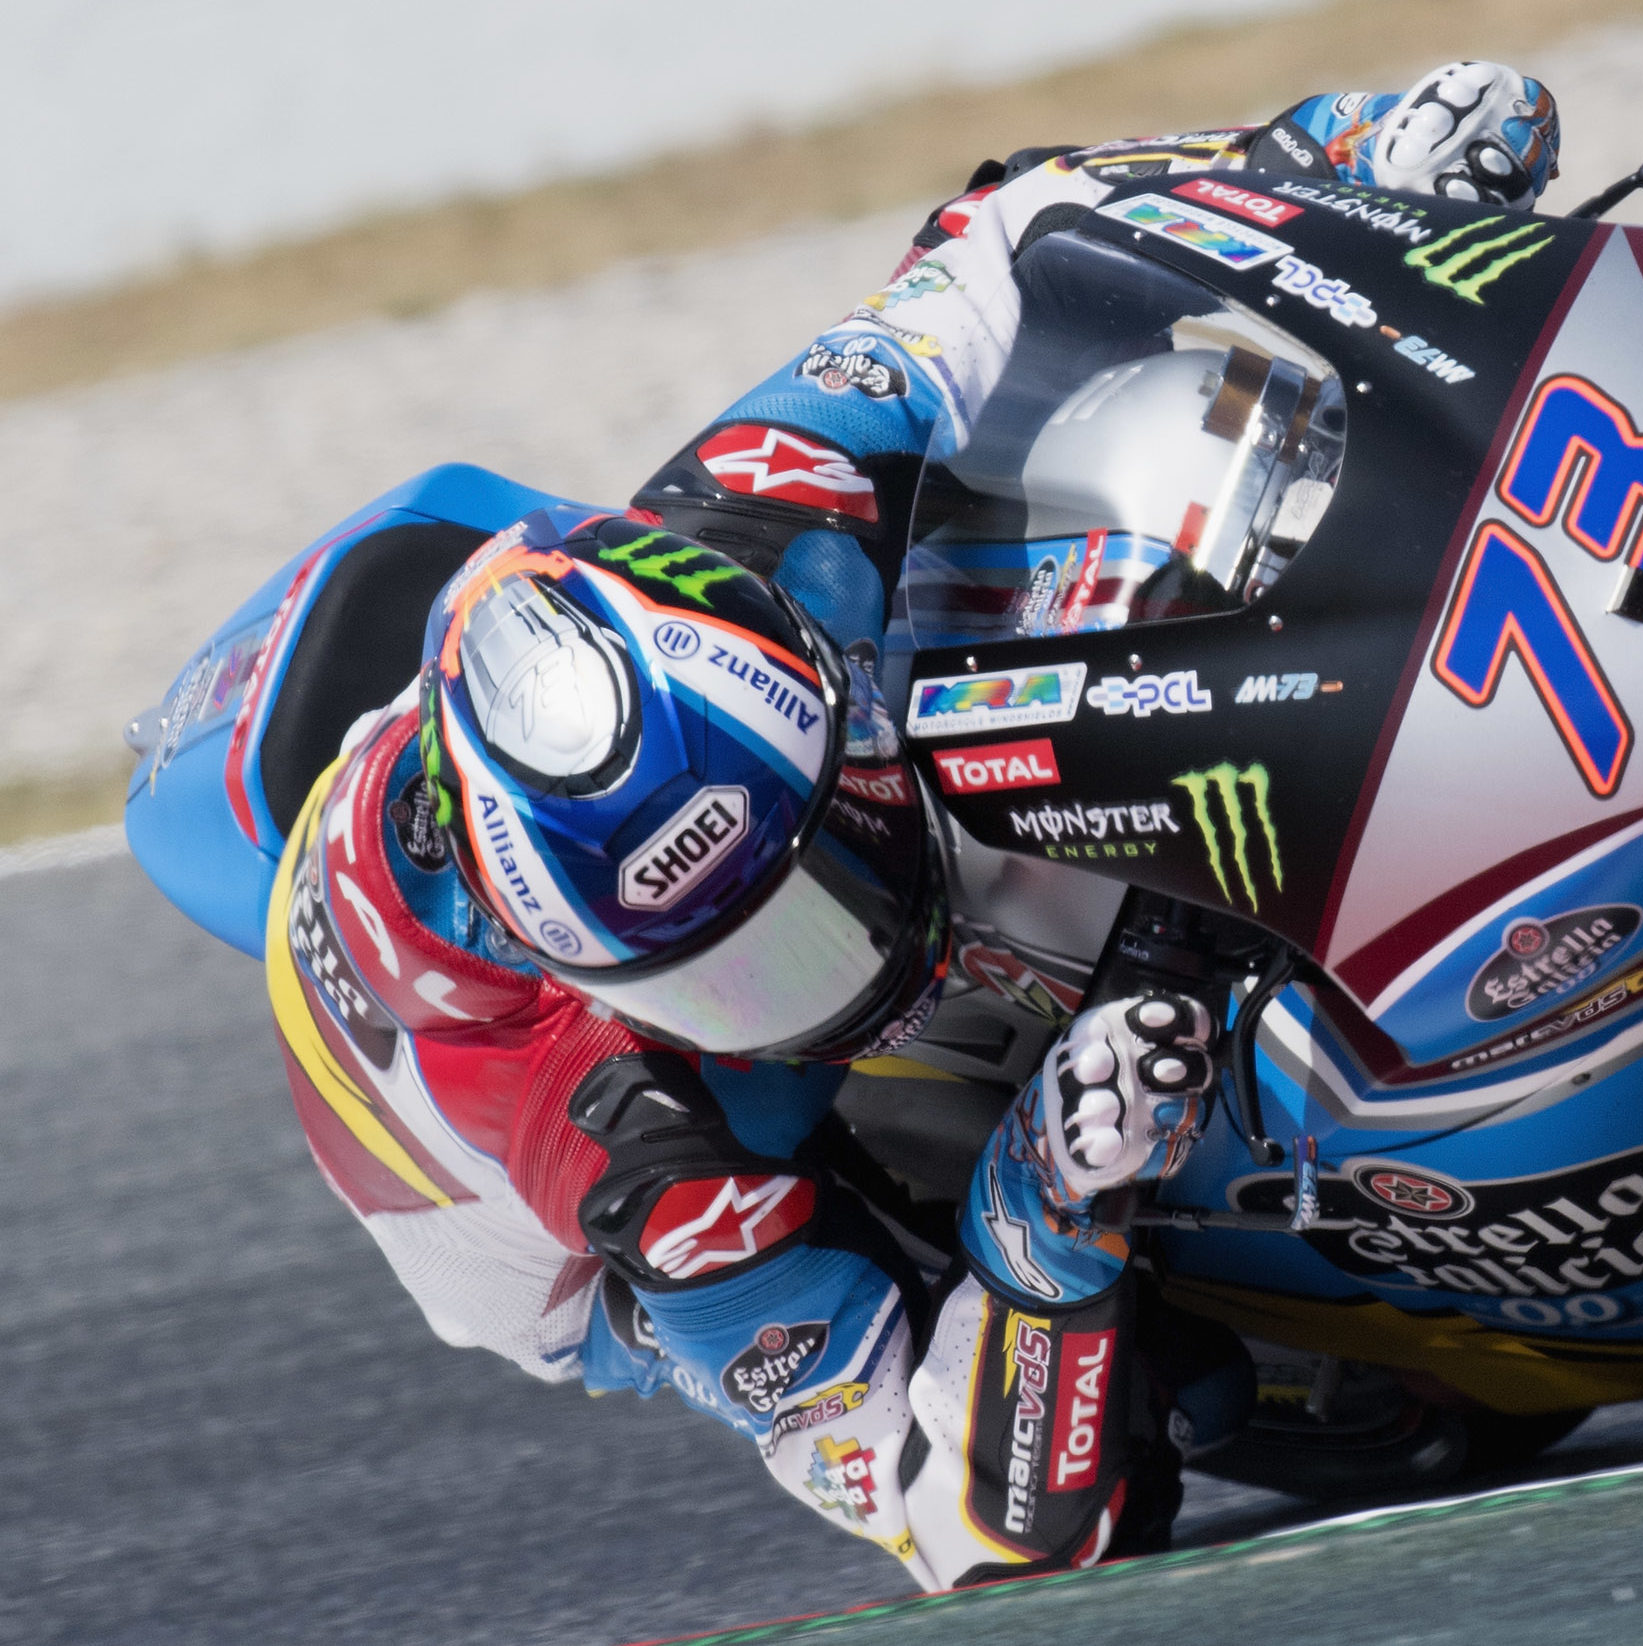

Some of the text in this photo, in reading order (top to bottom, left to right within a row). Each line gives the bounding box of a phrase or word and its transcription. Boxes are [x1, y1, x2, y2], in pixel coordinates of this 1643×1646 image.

[1197, 181, 1286, 221] TOTAL
[1272, 181, 1432, 243] MONSTER
[1320, 183, 1427, 217] ENERGY
[709, 644, 819, 734] Allianz
[918, 673, 1061, 718] MRA
[941, 754, 1053, 787] TOTAL
[634, 800, 738, 900] SHOEI
[1010, 803, 1180, 841] MONSTER
[1047, 842, 1157, 859] ENERGY
[478, 792, 542, 918] Allianz
[1484, 918, 1613, 1004] Estrella
[1508, 934, 1621, 1008] Galicia
[1057, 1338, 1108, 1486] TOTAL
